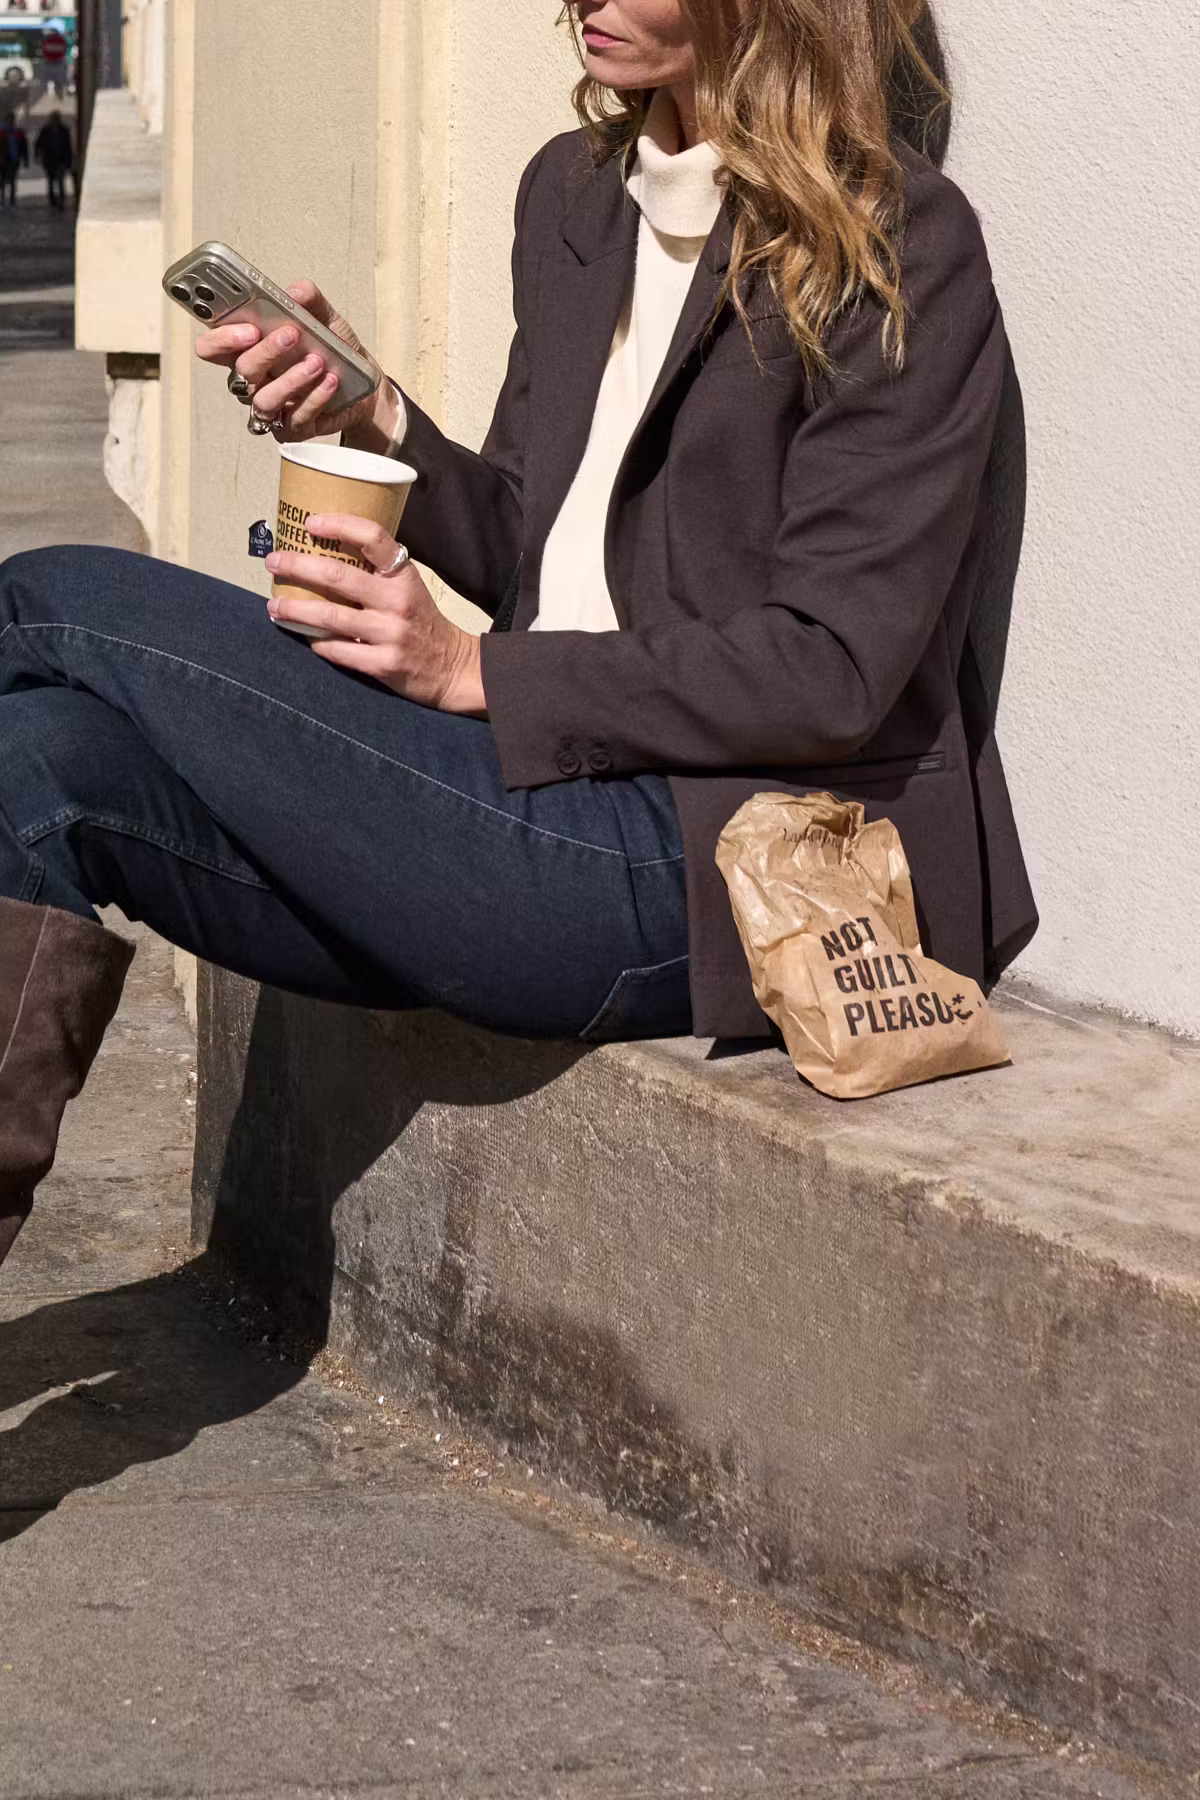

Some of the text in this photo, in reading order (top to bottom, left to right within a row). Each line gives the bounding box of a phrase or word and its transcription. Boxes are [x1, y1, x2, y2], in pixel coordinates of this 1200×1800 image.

[276, 518, 342, 552] COFFEE FOR
[820, 917, 878, 961] NOT
